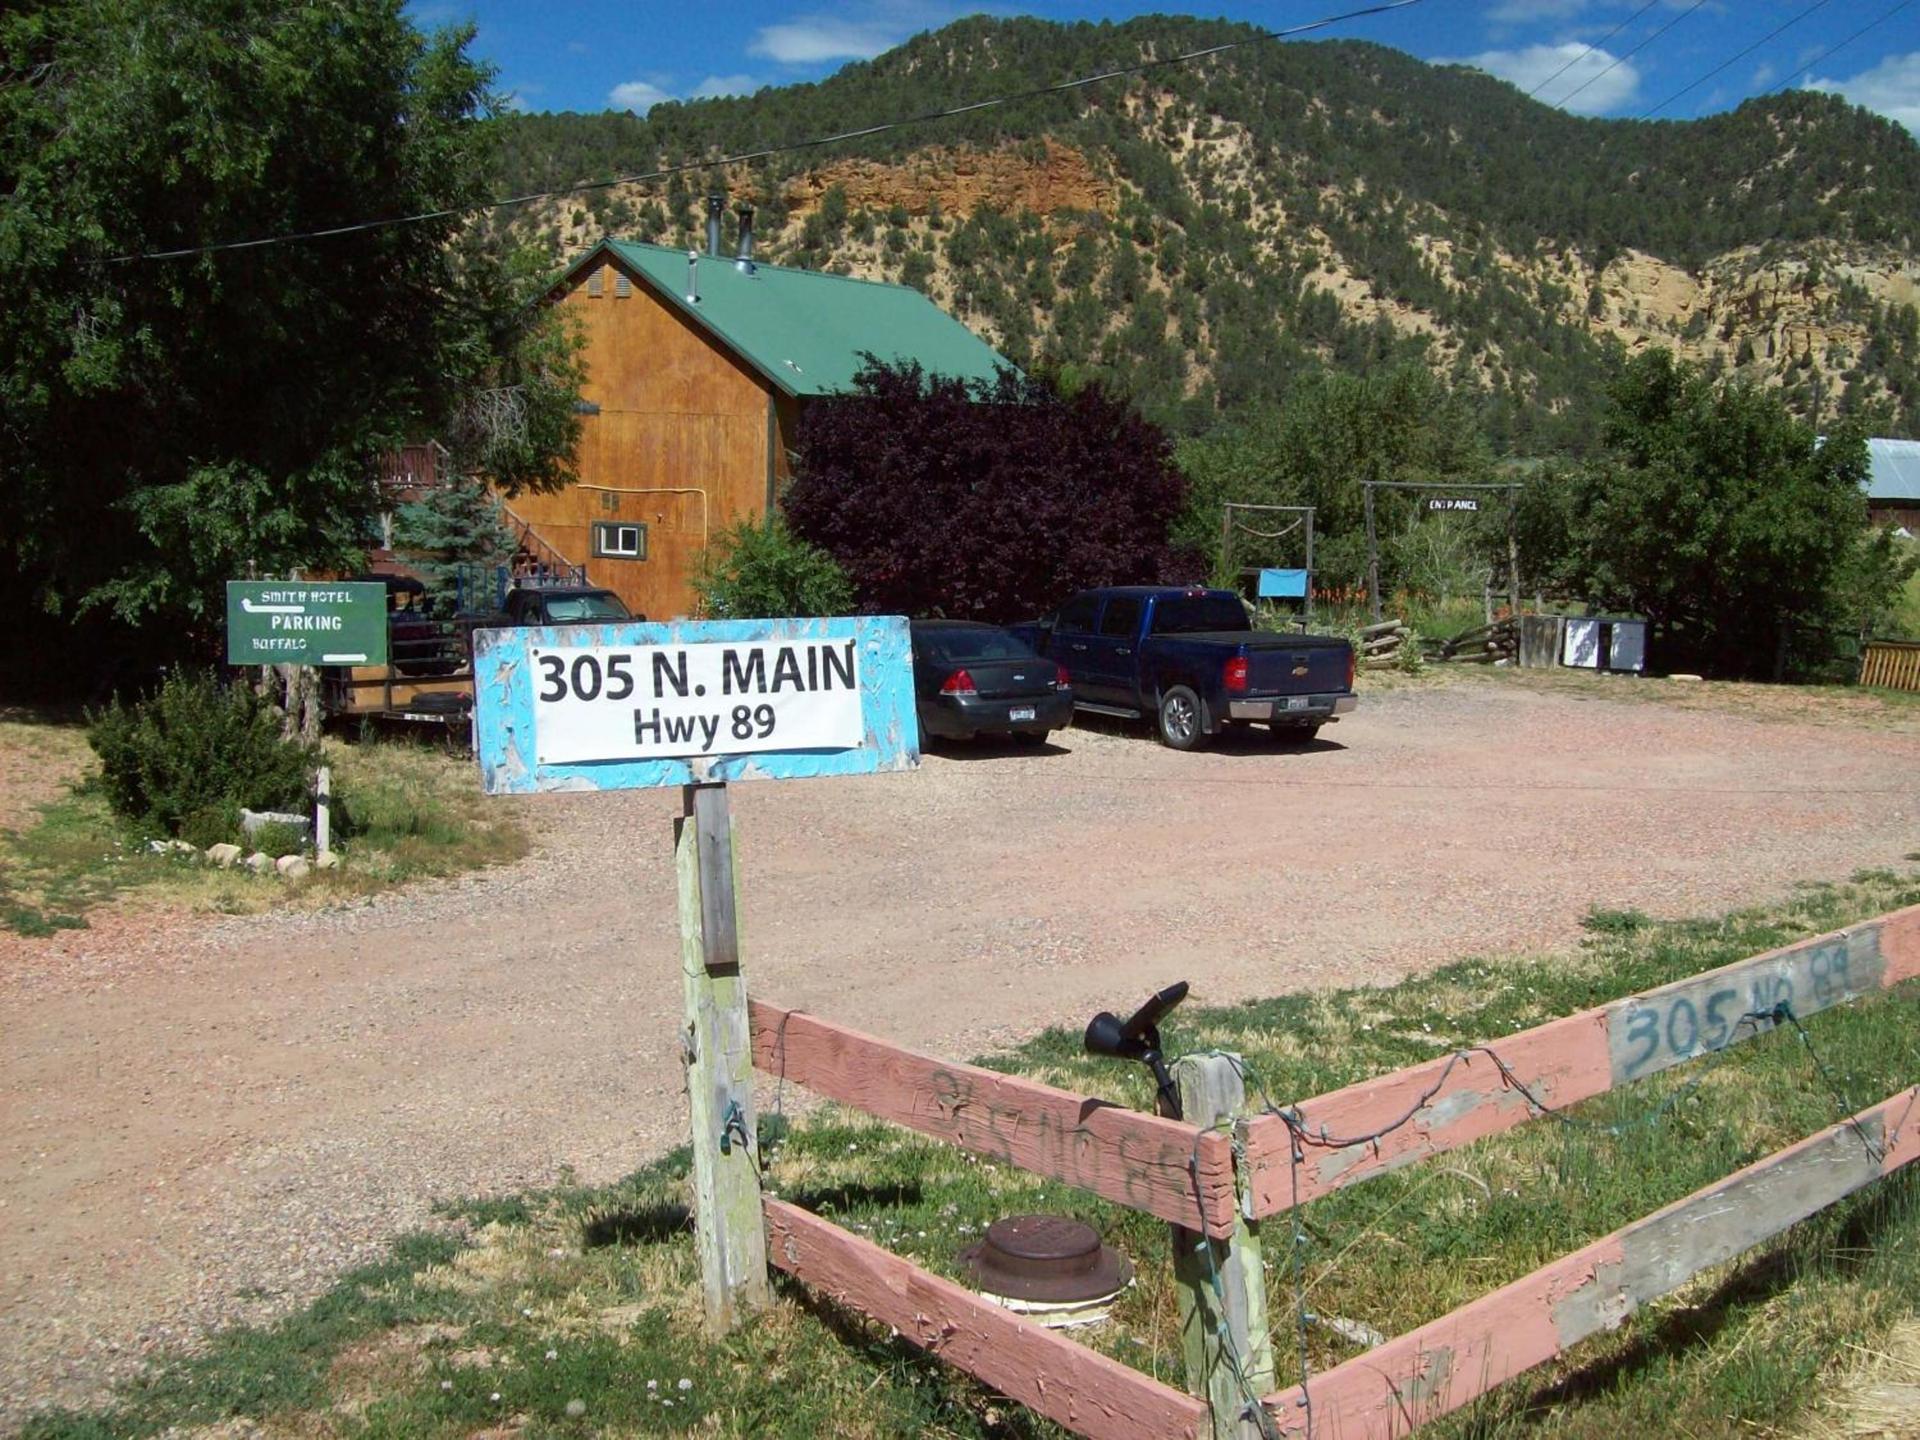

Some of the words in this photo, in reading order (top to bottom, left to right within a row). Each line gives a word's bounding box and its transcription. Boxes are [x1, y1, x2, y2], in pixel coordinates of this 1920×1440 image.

[262, 591, 306, 603] SMITH
[311, 592, 353, 603] HOTEL
[271, 615, 343, 631] PARKING
[252, 638, 307, 650] BUFFALO
[538, 654, 635, 702] 305
[653, 651, 707, 699] N.
[722, 646, 856, 696] MAIN
[634, 708, 720, 752] Hwy
[731, 704, 777, 741] 89
[1625, 990, 1737, 1076] 305
